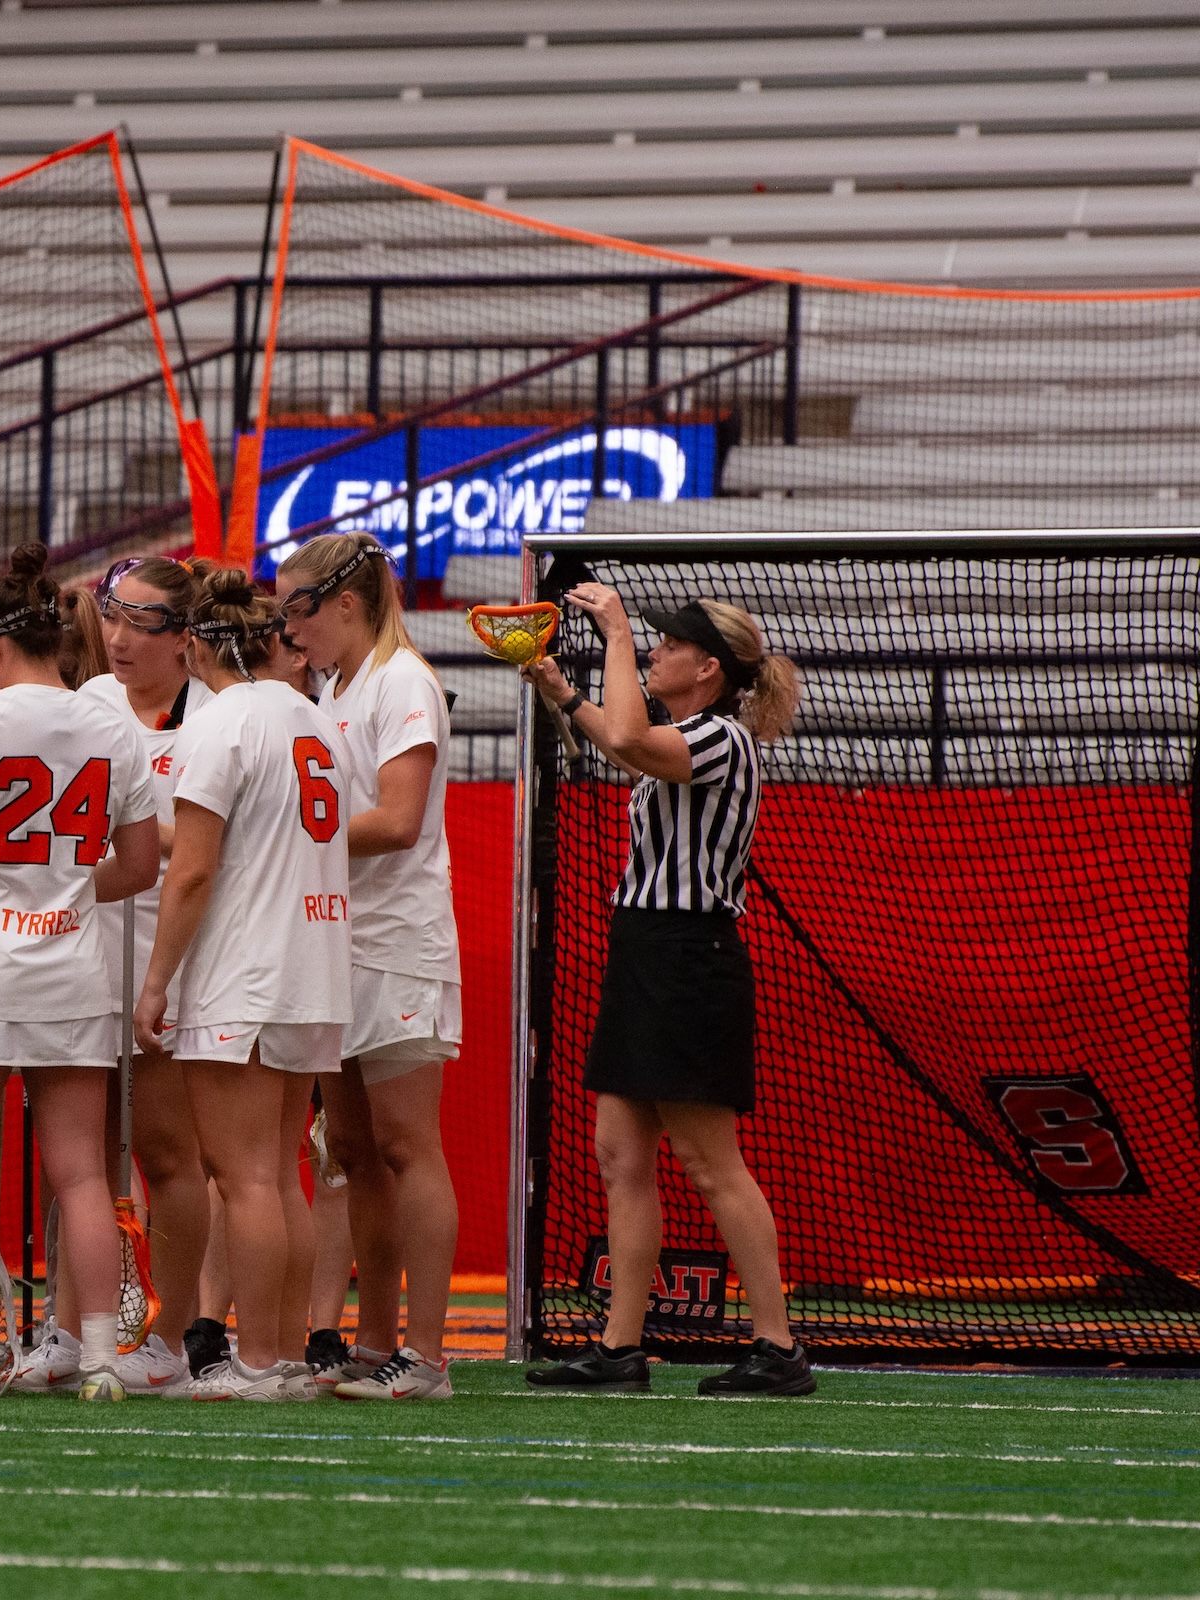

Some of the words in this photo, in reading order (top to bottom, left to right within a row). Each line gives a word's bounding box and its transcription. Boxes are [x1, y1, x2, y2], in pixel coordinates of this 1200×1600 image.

[340, 560, 358, 578] GAIT
[318, 577, 337, 594] GAIT
[403, 710, 426, 725] ACC
[293, 736, 340, 843] 6
[2, 908, 80, 936] TYRRELL
[1000, 1086, 1129, 1191] S
